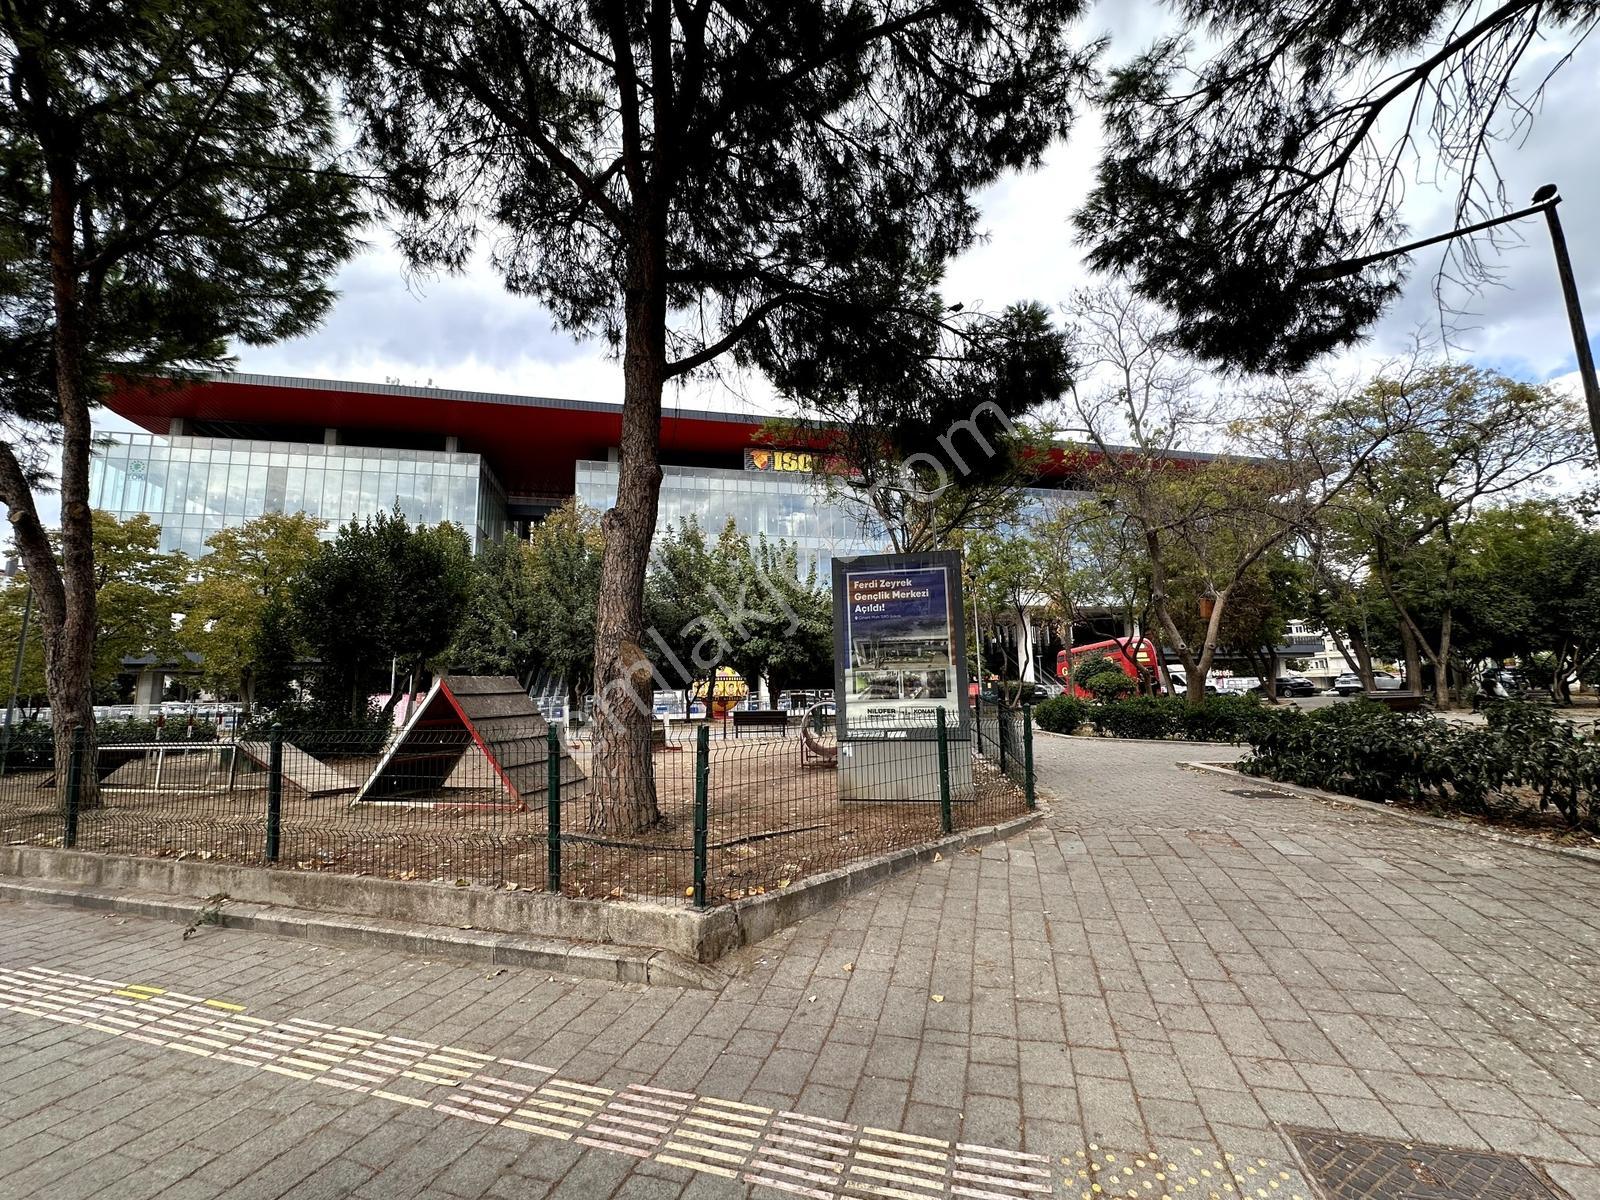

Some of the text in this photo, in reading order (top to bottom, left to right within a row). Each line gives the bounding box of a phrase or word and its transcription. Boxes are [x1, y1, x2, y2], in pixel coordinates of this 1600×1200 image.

[854, 578, 912, 590] Ferdi Zeyrek
[854, 588, 929, 602] Gençlik Merkezi
[854, 603, 885, 614] Açıldı!
